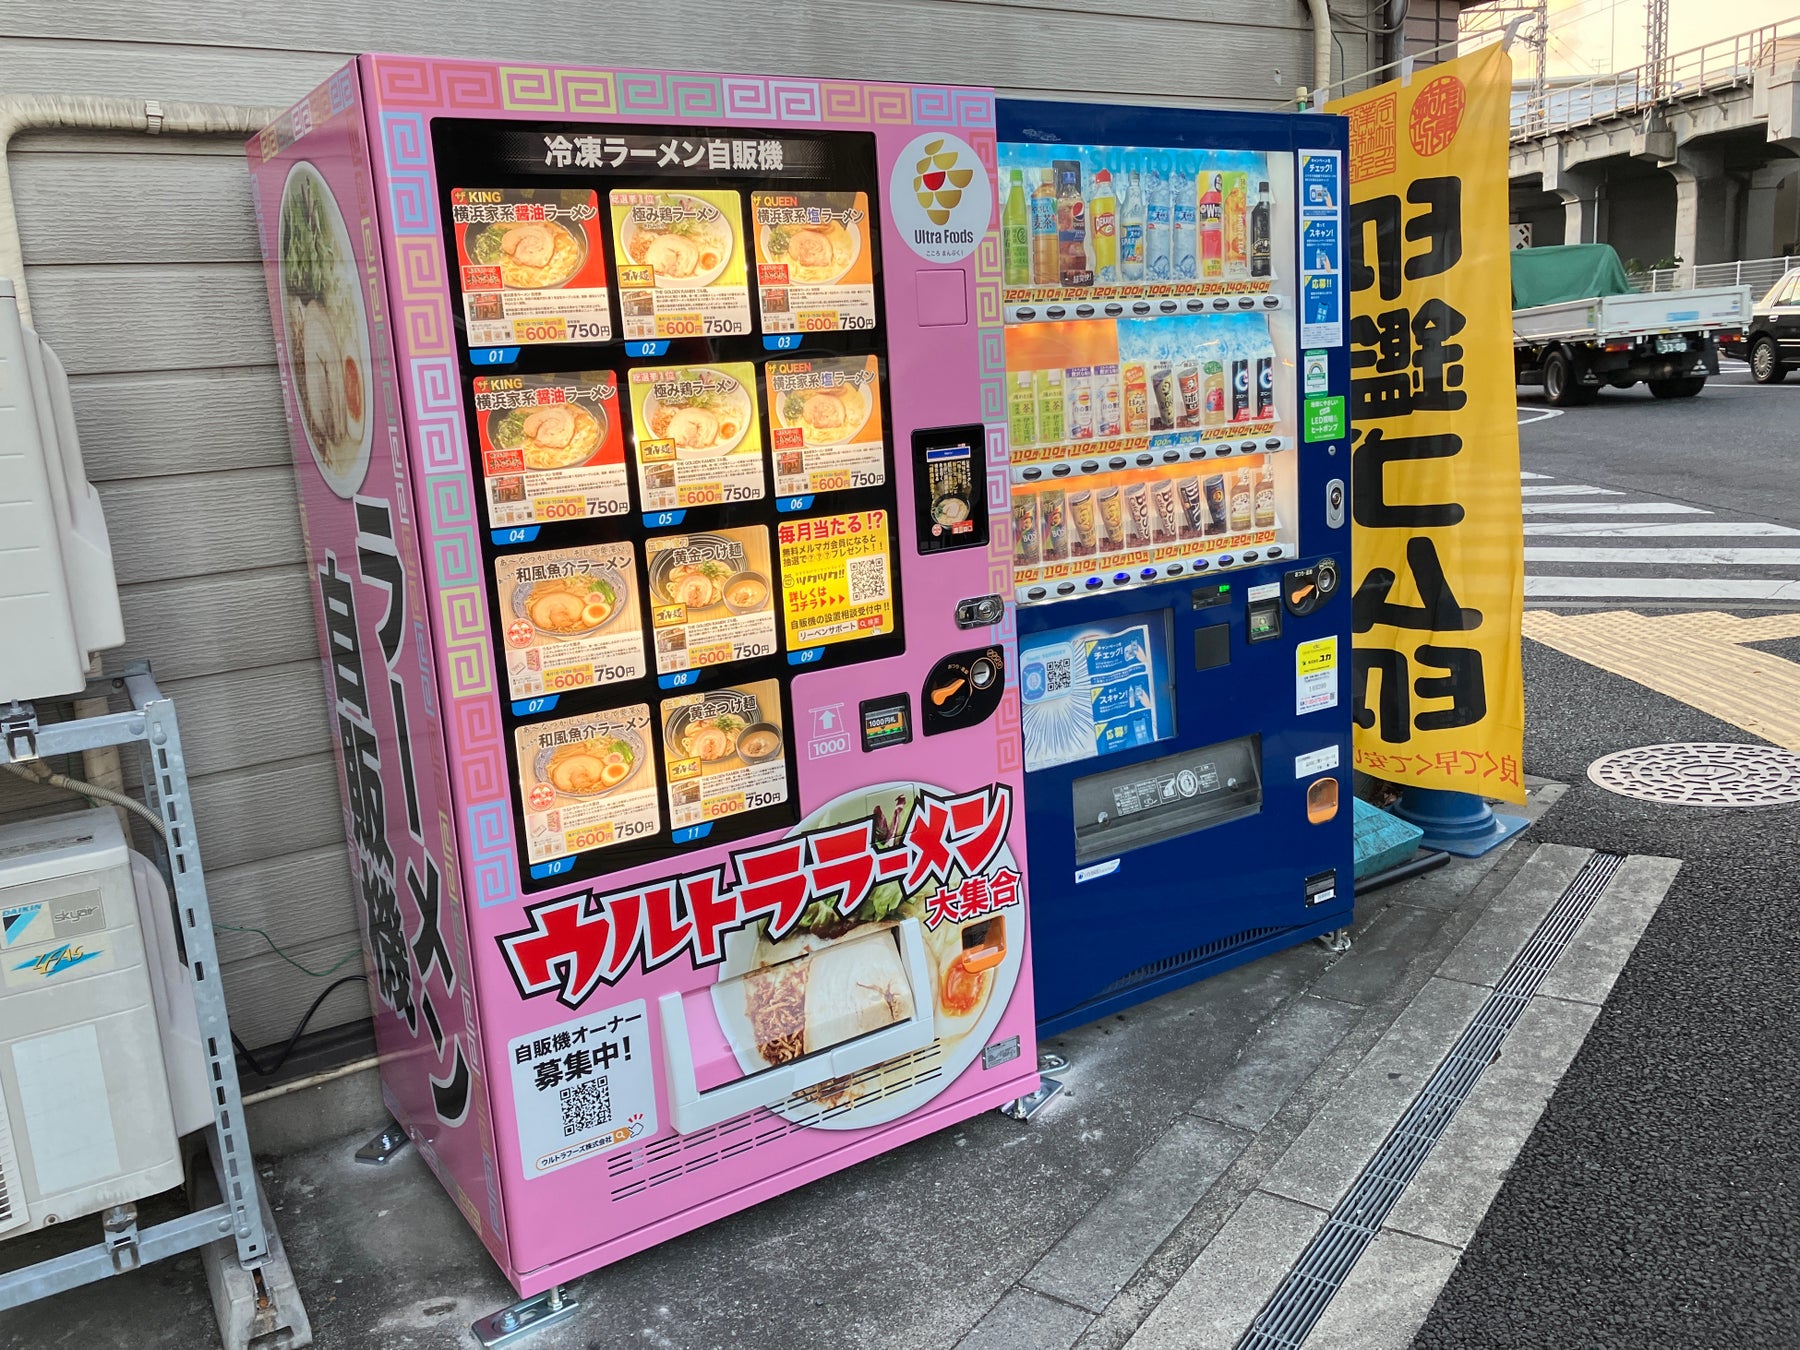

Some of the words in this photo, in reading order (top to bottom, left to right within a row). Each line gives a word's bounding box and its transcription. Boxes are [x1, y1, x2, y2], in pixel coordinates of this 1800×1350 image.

[543, 135, 784, 171] 冷凍ラーメン自販機
[1309, 164, 1333, 173] チェック!
[455, 192, 465, 201] ザ
[469, 191, 502, 202] KING
[753, 196, 761, 206] ザ
[765, 197, 797, 206] QUEEN
[453, 205, 596, 221] 横浜家系醤油ラーメン
[632, 206, 720, 222] 極み鶏ラーメン
[758, 208, 863, 224] 横浜家系塩ラーメン
[1034, 215, 1053, 229] 麦茶
[914, 229, 942, 244] Ultra
[944, 229, 974, 244] Foods
[1309, 229, 1334, 237] スキャン!
[1064, 288, 1089, 297] 120円
[1093, 287, 1117, 296] 120円
[1121, 286, 1144, 295] 100円
[1148, 284, 1170, 294] 100円
[1174, 284, 1196, 293] 100円
[1200, 283, 1221, 293] 130円
[1225, 282, 1246, 292] 140円
[1249, 281, 1270, 292] 140円
[1006, 289, 1031, 298] 120円
[1037, 289, 1061, 298] 110円
[666, 321, 702, 334] 600円
[704, 319, 741, 333] 750円
[806, 318, 838, 330] 600円
[841, 317, 874, 329] 750円
[525, 326, 566, 340] 600円
[568, 324, 611, 338] 750円
[778, 337, 791, 348] 03
[642, 343, 655, 355] 02
[489, 350, 504, 362] 01
[768, 365, 777, 374] ザ
[779, 362, 812, 373] QUEEN
[477, 381, 488, 391] ザ
[491, 378, 522, 391] KING
[773, 370, 876, 391] 横浜家系塩ラーメン
[654, 379, 738, 398] 極み鶏ラーメン
[476, 385, 616, 410] 横浜家系醤油ラーメン
[1204, 429, 1226, 437] 110円
[1228, 426, 1249, 435] 140円
[1253, 424, 1273, 433] 140円
[1071, 443, 1096, 453] 110円
[1099, 440, 1122, 450] 110円
[1125, 437, 1148, 447] 110円
[1012, 451, 1039, 460] 110円
[1042, 447, 1066, 457] 110円
[819, 477, 850, 490] 600円
[851, 473, 884, 486] 750円
[688, 491, 722, 504] 600円
[724, 487, 760, 500] 750円
[587, 500, 628, 515] 750円
[791, 499, 802, 509] 06
[546, 504, 584, 518] 600円
[658, 514, 672, 524] 05
[510, 530, 525, 541] 04
[1231, 535, 1251, 544] 120円
[1254, 531, 1275, 541] 120円
[783, 534, 877, 557] 無料メルマガ会員になると
[1183, 543, 1205, 552] 110円
[1207, 539, 1228, 548] 110円
[672, 542, 744, 566] 黄金つけ麺
[1127, 552, 1149, 561] 110円
[1156, 548, 1178, 557] 110円
[1073, 561, 1096, 570] 110円
[1101, 555, 1125, 565] 110円
[516, 556, 632, 583] 和風魚介ラーメン
[1016, 571, 1038, 580] 110円
[1045, 565, 1068, 574] 110円
[789, 586, 827, 601] 詳しくは
[791, 599, 818, 612] コチラ
[800, 622, 856, 640] リーベンサポート
[733, 643, 769, 659] 750円
[801, 651, 813, 661] 09
[1094, 647, 1123, 660] チェック!
[698, 650, 732, 665] 600円
[594, 666, 635, 682] 750円
[674, 673, 687, 684] 08
[554, 673, 592, 688] 600円
[1100, 692, 1128, 704] スキャン!
[529, 700, 544, 711] 07
[689, 696, 756, 721] 黄金つけ麺
[538, 717, 650, 748] 和風魚介ラーメン
[813, 738, 845, 756] 1000
[745, 792, 780, 808] 750円
[352, 496, 472, 1128] ラーメン
[711, 801, 744, 816] 600円
[614, 821, 654, 838] 750円
[688, 828, 699, 838] 11
[575, 832, 613, 848] 600円
[548, 862, 560, 873] 10
[497, 783, 1015, 1010] ウルトララーメン
[925, 867, 1021, 930] 大集合
[2, 904, 42, 917] DAIKIN
[54, 906, 98, 922] skyair
[514, 1013, 642, 1064] 自販機オーナー
[534, 1036, 632, 1091] 募集中!
[540, 1135, 613, 1166] ウルトラフーズ株式会社
